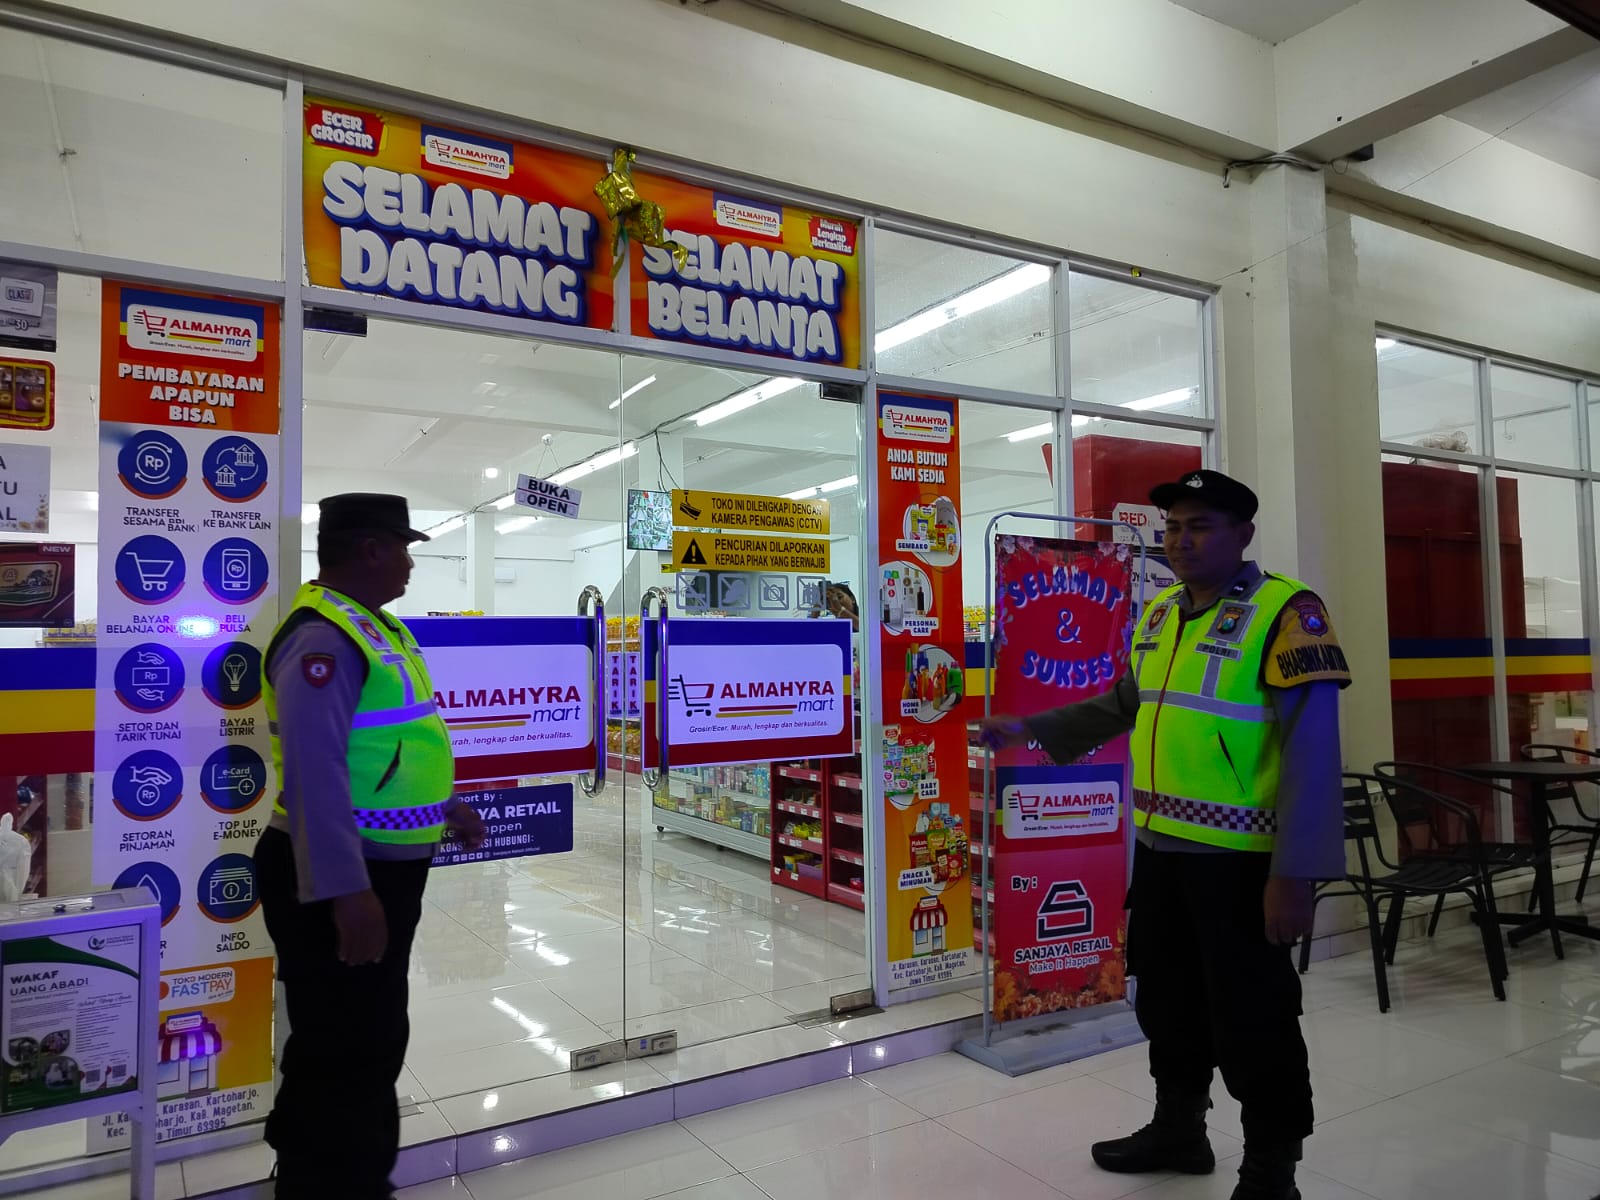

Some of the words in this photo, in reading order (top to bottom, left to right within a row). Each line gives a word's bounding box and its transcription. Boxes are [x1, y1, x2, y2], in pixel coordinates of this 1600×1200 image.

[322, 109, 363, 131] ECER
[311, 123, 374, 150] GROSIR
[453, 146, 506, 164] ALMAHYRA
[488, 161, 506, 170] mart
[322, 160, 591, 260] SELAMAT
[736, 209, 777, 224] ALMAHYRA
[816, 228, 847, 243] Lengkap
[340, 226, 579, 319] DATANG
[641, 228, 840, 305] SELAMAT
[647, 280, 837, 358] BELANJA
[169, 319, 252, 338] ALMAHYRA
[224, 337, 252, 348] mart
[118, 362, 265, 393] PEMBAYARAN
[149, 385, 235, 407] APAPUN
[168, 405, 216, 424] BISA
[904, 414, 948, 427] ALMAHYRA
[144, 454, 164, 471] Rp
[887, 447, 914, 464] ANDA
[916, 449, 948, 467] BUTUH
[890, 465, 915, 482] KAMI
[917, 466, 945, 483] SEDIA
[528, 478, 570, 500] BUKA
[526, 494, 569, 514] OPEN
[711, 497, 733, 511] TOKO
[735, 498, 745, 511] INI
[746, 499, 791, 514] DILENGKAPI
[792, 501, 822, 516] DENGAN
[126, 506, 180, 518] TRANSFER
[210, 509, 262, 521] TRANSFER
[1119, 511, 1148, 526] RED
[123, 516, 166, 527] SESAMA
[167, 523, 195, 533] BANK
[203, 519, 217, 528] KE
[218, 519, 247, 529] BANK
[249, 520, 272, 530] LAIN
[711, 511, 743, 526] KAMERA
[744, 513, 795, 529] PENGAWAS
[796, 516, 823, 532] (CCTV)
[42, 545, 72, 554] NEW
[714, 538, 768, 553] PENCURIAN
[769, 540, 825, 555] DILAPORKAN
[897, 541, 929, 551] SEMBAKO
[714, 552, 744, 567] KEPADA
[745, 553, 768, 567] PIHAK
[769, 554, 790, 568] YANG
[790, 555, 826, 569] BERWAJIB
[1008, 564, 1125, 611] SELAMAT
[133, 614, 170, 624] BAYAR
[226, 614, 245, 624] BELI
[904, 619, 937, 628] PERSONAL
[1056, 607, 1082, 643] &
[106, 624, 154, 634] BELANJA
[219, 624, 251, 634] PULSA
[913, 626, 930, 634] CARE
[1020, 649, 1116, 688] SUKSES
[143, 670, 158, 683] Rp
[611, 655, 620, 710] TARIK
[629, 655, 638, 710] TARIK
[433, 685, 582, 709] ALMAHYRA
[720, 680, 835, 699] ALMAHYRA
[798, 697, 835, 712] mart
[903, 701, 920, 709] HOME
[904, 707, 919, 715] CARE
[533, 705, 581, 723] mart
[118, 722, 154, 733] SETOR
[155, 721, 180, 732] DAN
[219, 717, 255, 728] BAYAR
[730, 723, 753, 731] Murah,
[754, 722, 780, 732] lengkap
[780, 721, 793, 729] dan
[115, 731, 147, 743] TARIK
[148, 730, 182, 741] TUNAI
[219, 726, 255, 737] LISTRIK
[473, 735, 507, 747] lengkap
[509, 734, 525, 742] dan
[526, 731, 573, 742] berkualitas.
[222, 765, 251, 776] e-Card
[921, 781, 937, 790] BABY
[921, 788, 938, 797] CARE
[141, 788, 156, 801] Rp
[483, 792, 496, 802] By
[1042, 792, 1115, 808] ALMAHYRA
[504, 801, 561, 819] RETAIL
[1091, 805, 1115, 817] mart
[218, 820, 242, 831] TOP
[244, 819, 257, 830] UP
[122, 829, 173, 842] SETORAN
[213, 827, 263, 840] E-MONEY
[494, 834, 535, 848] HUBUNGI:
[119, 838, 175, 853] PINJAMAN
[900, 877, 932, 887] MINUMAN
[902, 870, 924, 880] SNACK
[220, 931, 246, 943] INFO
[216, 940, 250, 953] SALDO
[1014, 944, 1071, 964] SANJAYA
[1072, 936, 1113, 955] RETAIL
[1029, 963, 1054, 975] Make
[1064, 955, 1100, 971] Happen
[10, 970, 60, 985] WAKAF
[172, 975, 197, 985] TOKO
[198, 970, 233, 982] MODERN
[10, 983, 47, 997] UANG
[50, 977, 89, 991] ABADI
[171, 977, 232, 999] FASTPAY
[106, 1126, 128, 1138] Kec.
[166, 1126, 193, 1139] Timur
